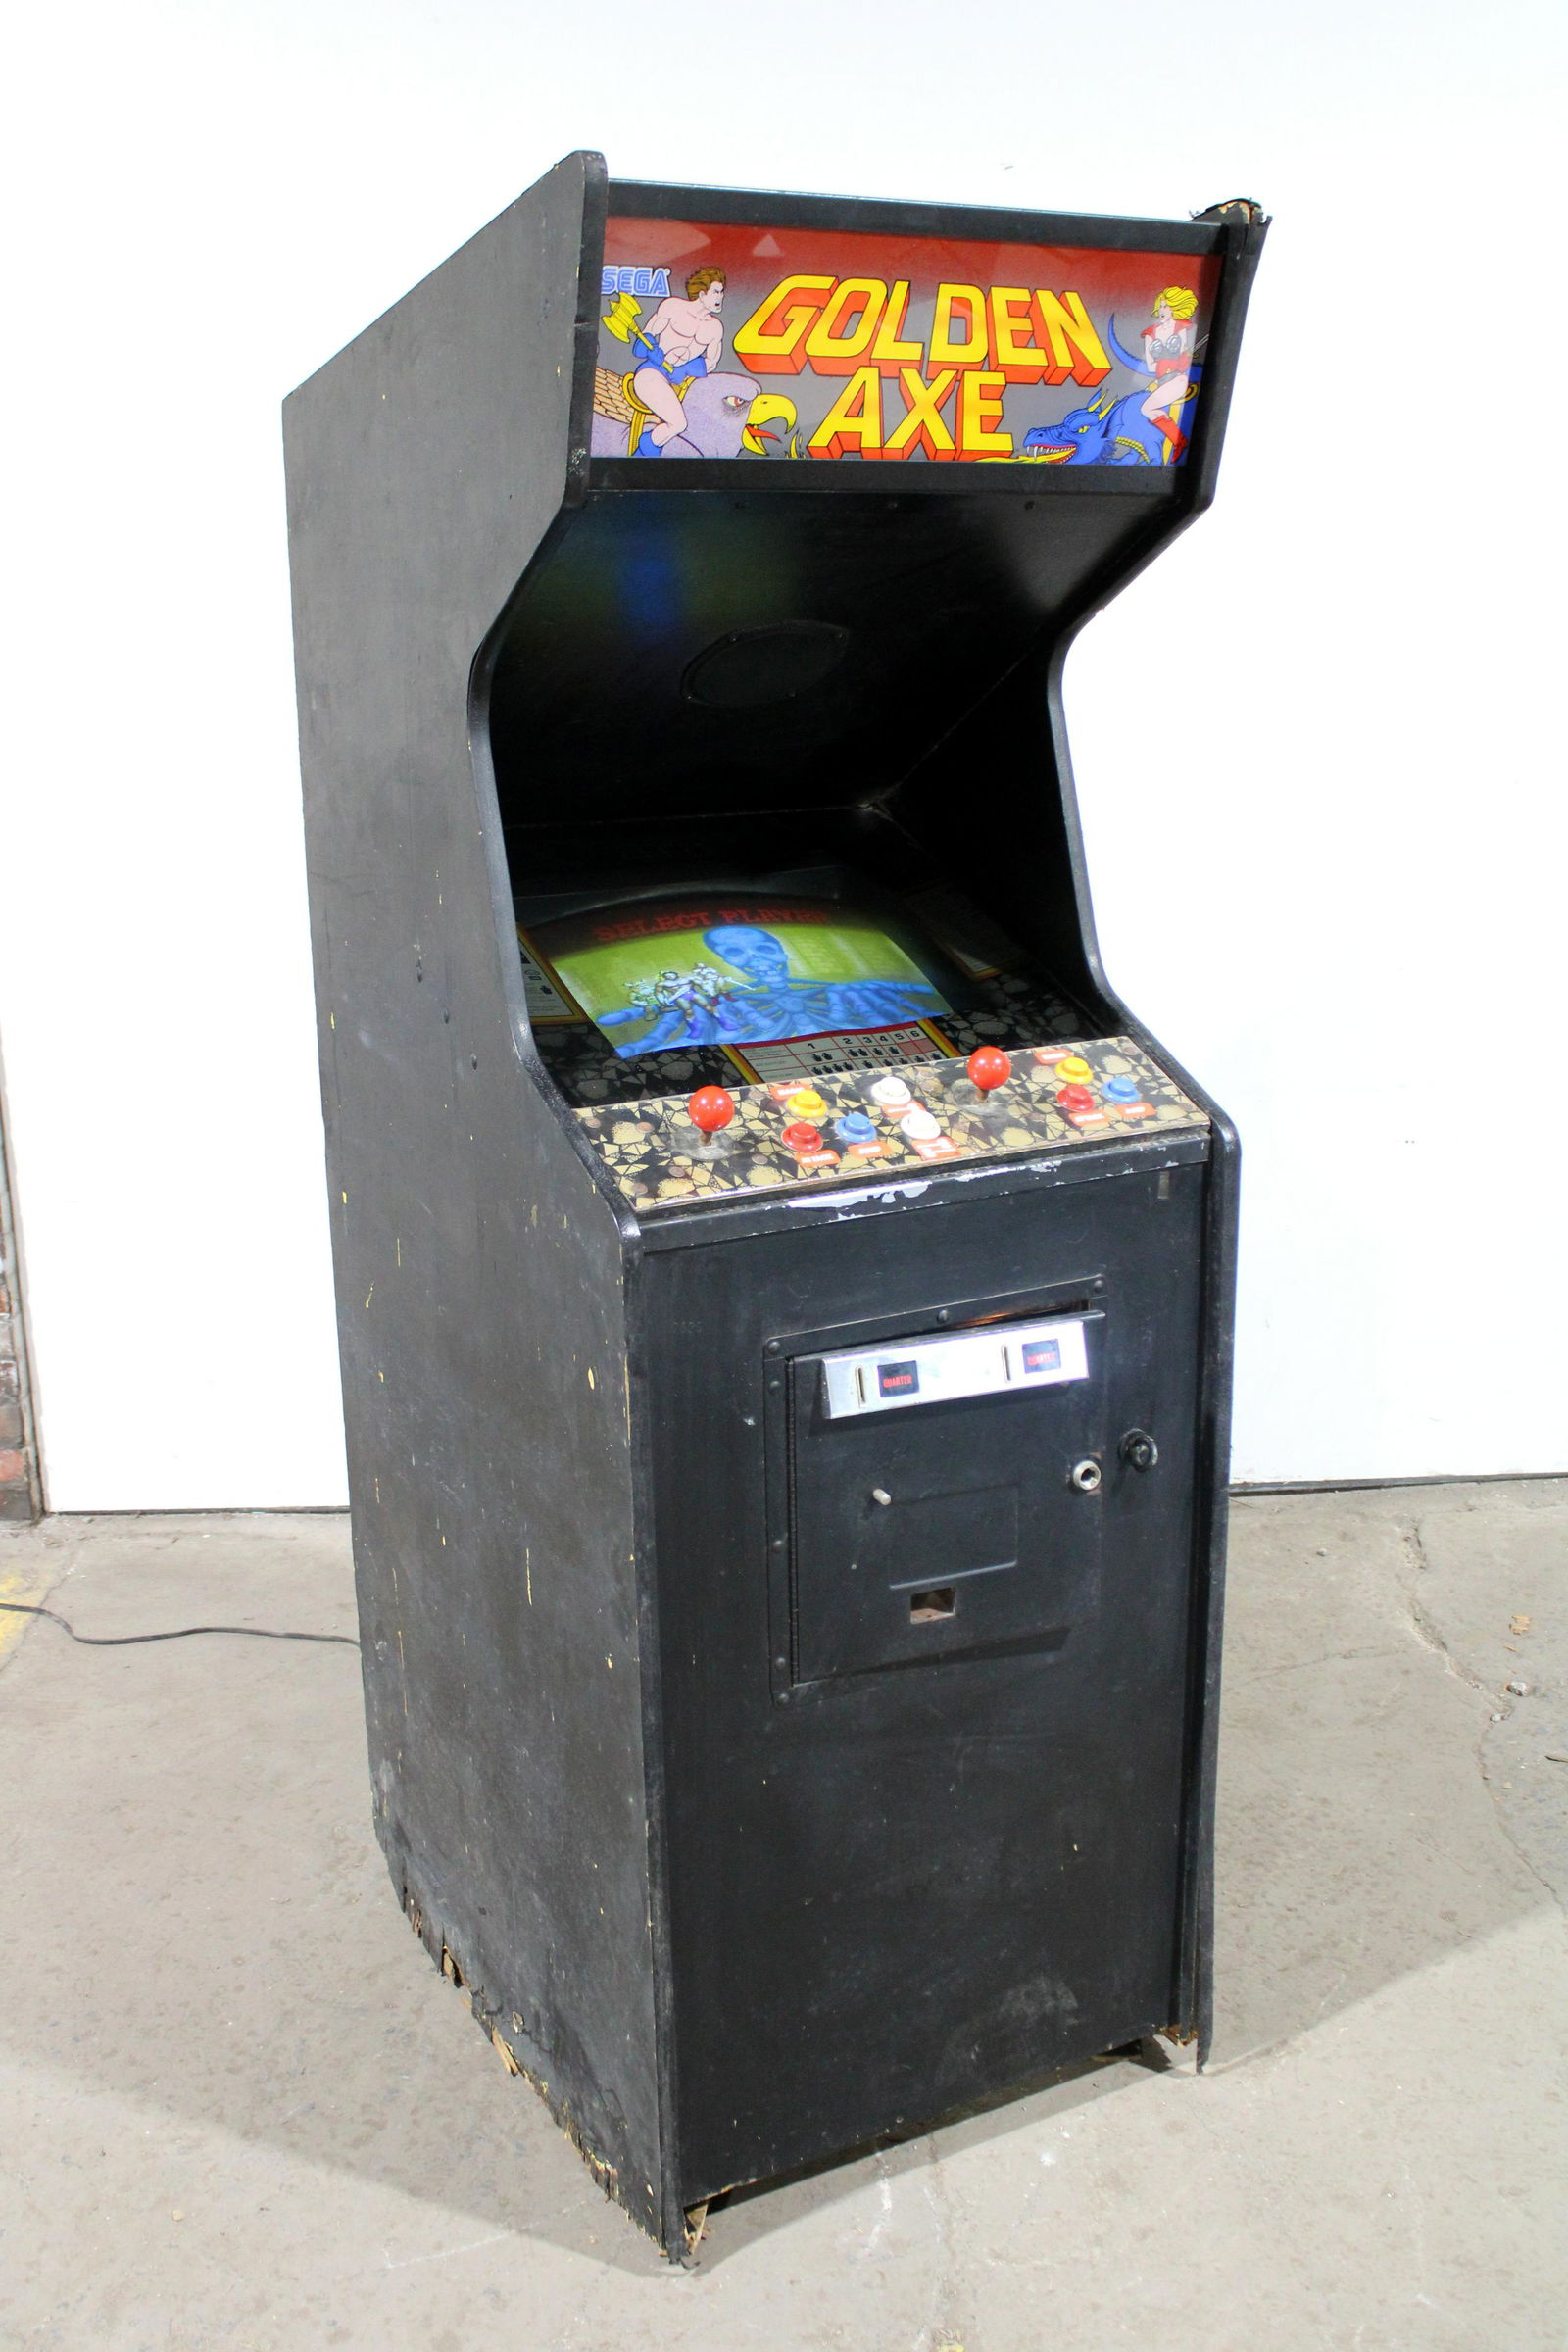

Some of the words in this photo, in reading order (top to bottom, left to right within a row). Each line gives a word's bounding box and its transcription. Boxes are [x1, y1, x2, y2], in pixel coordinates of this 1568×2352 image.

[602, 266, 670, 297] SEGA
[732, 274, 1113, 388] GOLDEN
[808, 367, 1015, 462] AXE
[592, 911, 712, 943] SELECT
[717, 907, 829, 926] PLAYER
[881, 1034, 893, 1043] 4
